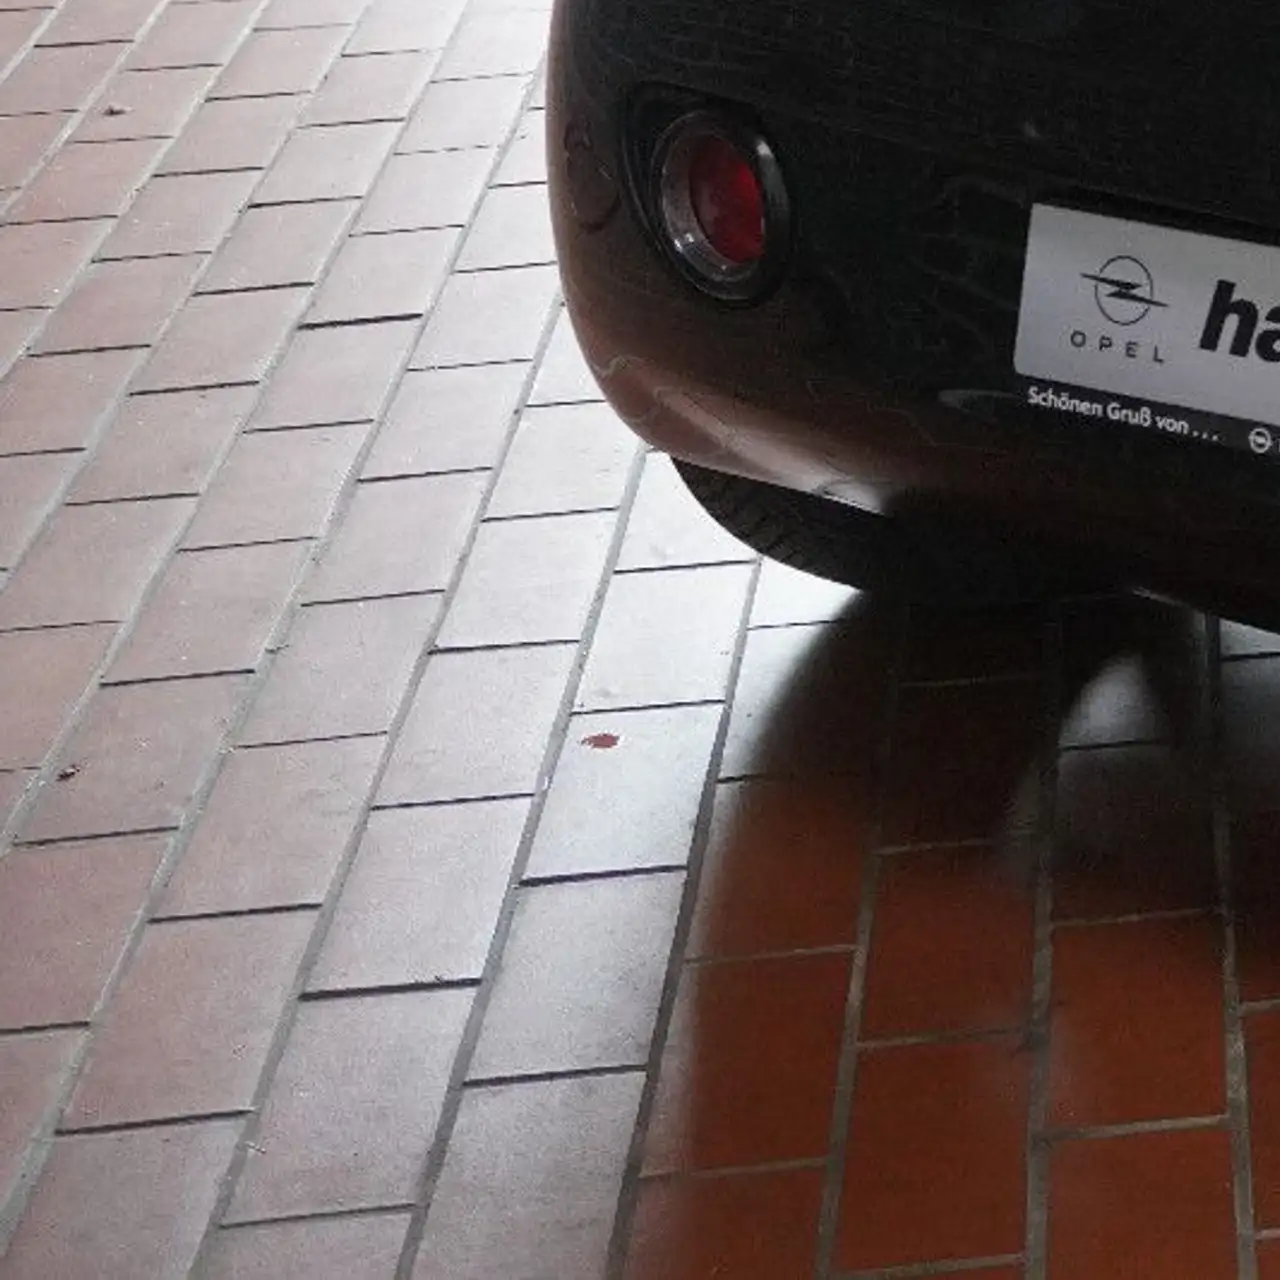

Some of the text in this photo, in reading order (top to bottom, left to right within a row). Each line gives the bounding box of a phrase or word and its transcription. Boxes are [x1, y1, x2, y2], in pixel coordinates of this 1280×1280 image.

[1071, 330, 1165, 363] OPEL
[1028, 386, 1103, 418] Schönen
[1106, 402, 1152, 433] Gruß
